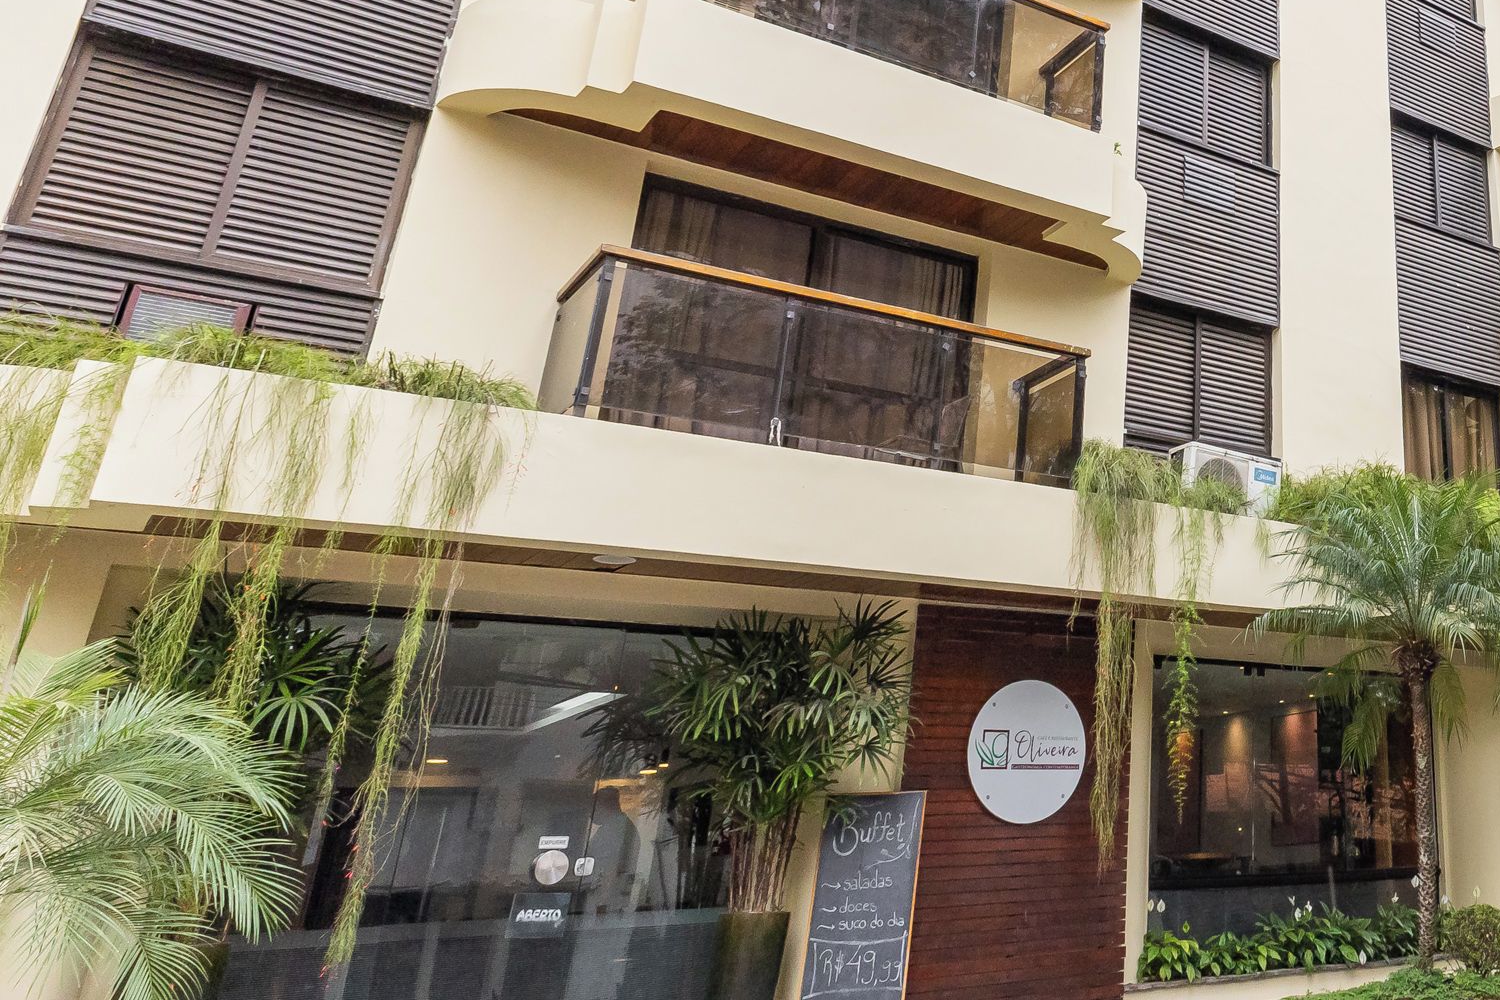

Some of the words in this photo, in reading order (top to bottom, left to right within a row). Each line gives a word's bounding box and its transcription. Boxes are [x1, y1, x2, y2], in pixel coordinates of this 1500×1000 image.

[1014, 729, 1079, 763] Oliveira
[832, 807, 906, 857] Buffet
[843, 869, 893, 892] saladas
[838, 896, 878, 914] doces
[515, 908, 563, 923] ABERTO
[838, 919, 867, 931] suco
[870, 914, 884, 929] do
[887, 913, 905, 928] dia
